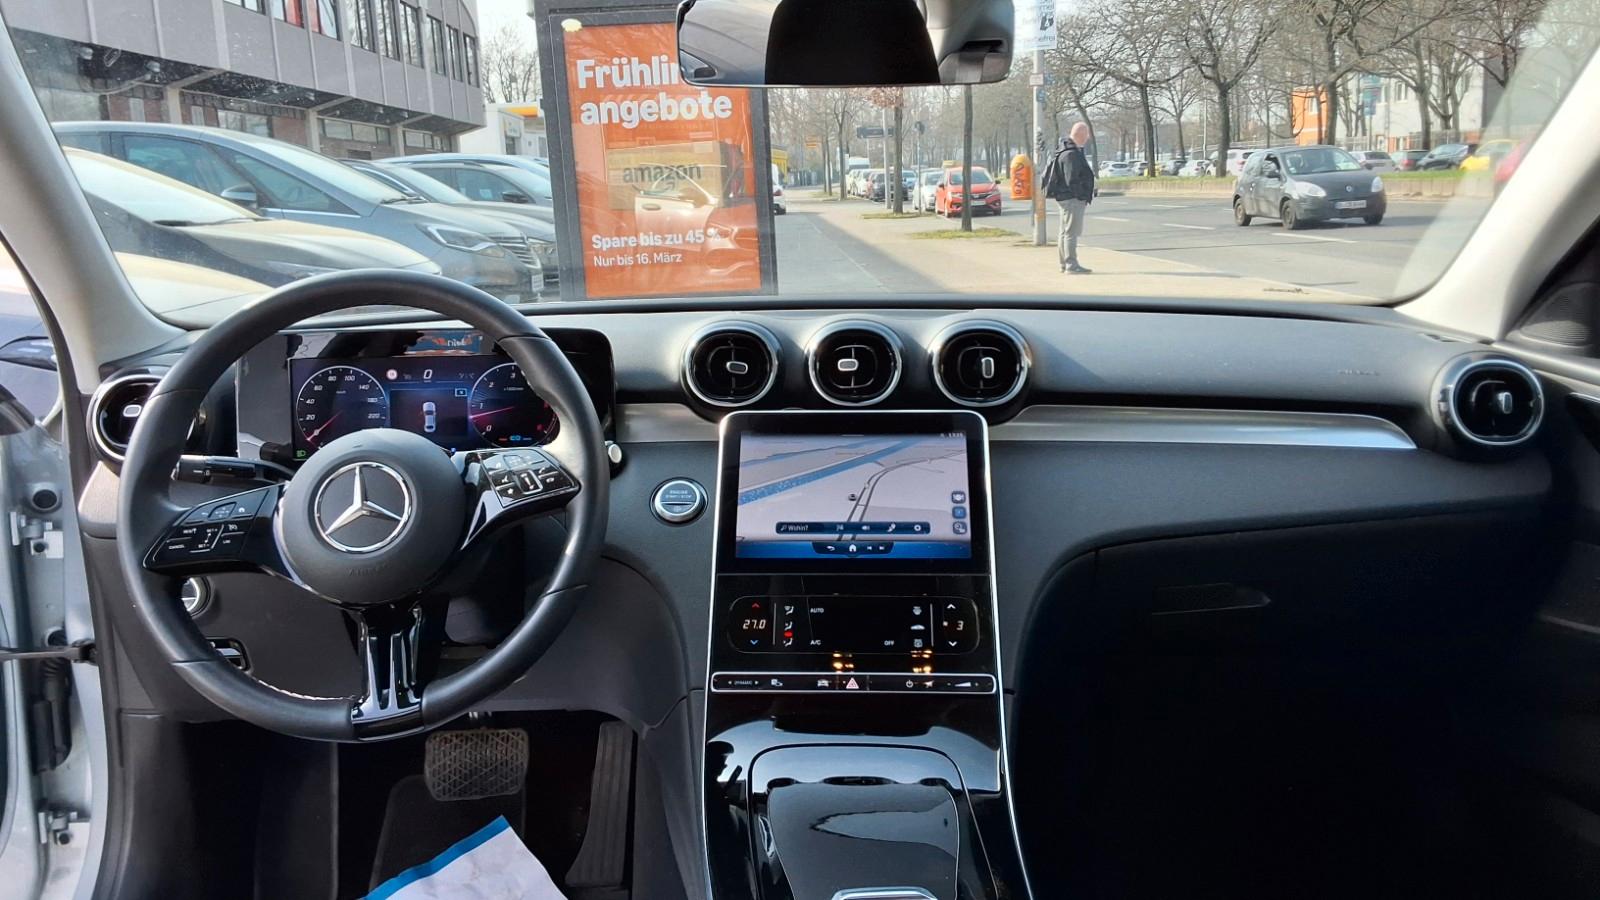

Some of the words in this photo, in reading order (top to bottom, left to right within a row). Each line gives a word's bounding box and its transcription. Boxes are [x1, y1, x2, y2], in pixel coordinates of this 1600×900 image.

[580, 91, 732, 129] angebote
[623, 164, 701, 183] amazon
[591, 234, 637, 251] Spare
[639, 231, 662, 247] bis
[665, 233, 683, 246] zu
[685, 229, 705, 244] 45
[593, 255, 614, 267] Nur
[617, 253, 634, 265] bis
[636, 252, 652, 265] 16.
[653, 251, 682, 264] März
[423, 369, 433, 380] 0
[788, 524, 809, 532] Wohin?
[742, 619, 767, 630] 27.0
[956, 620, 964, 631] 3
